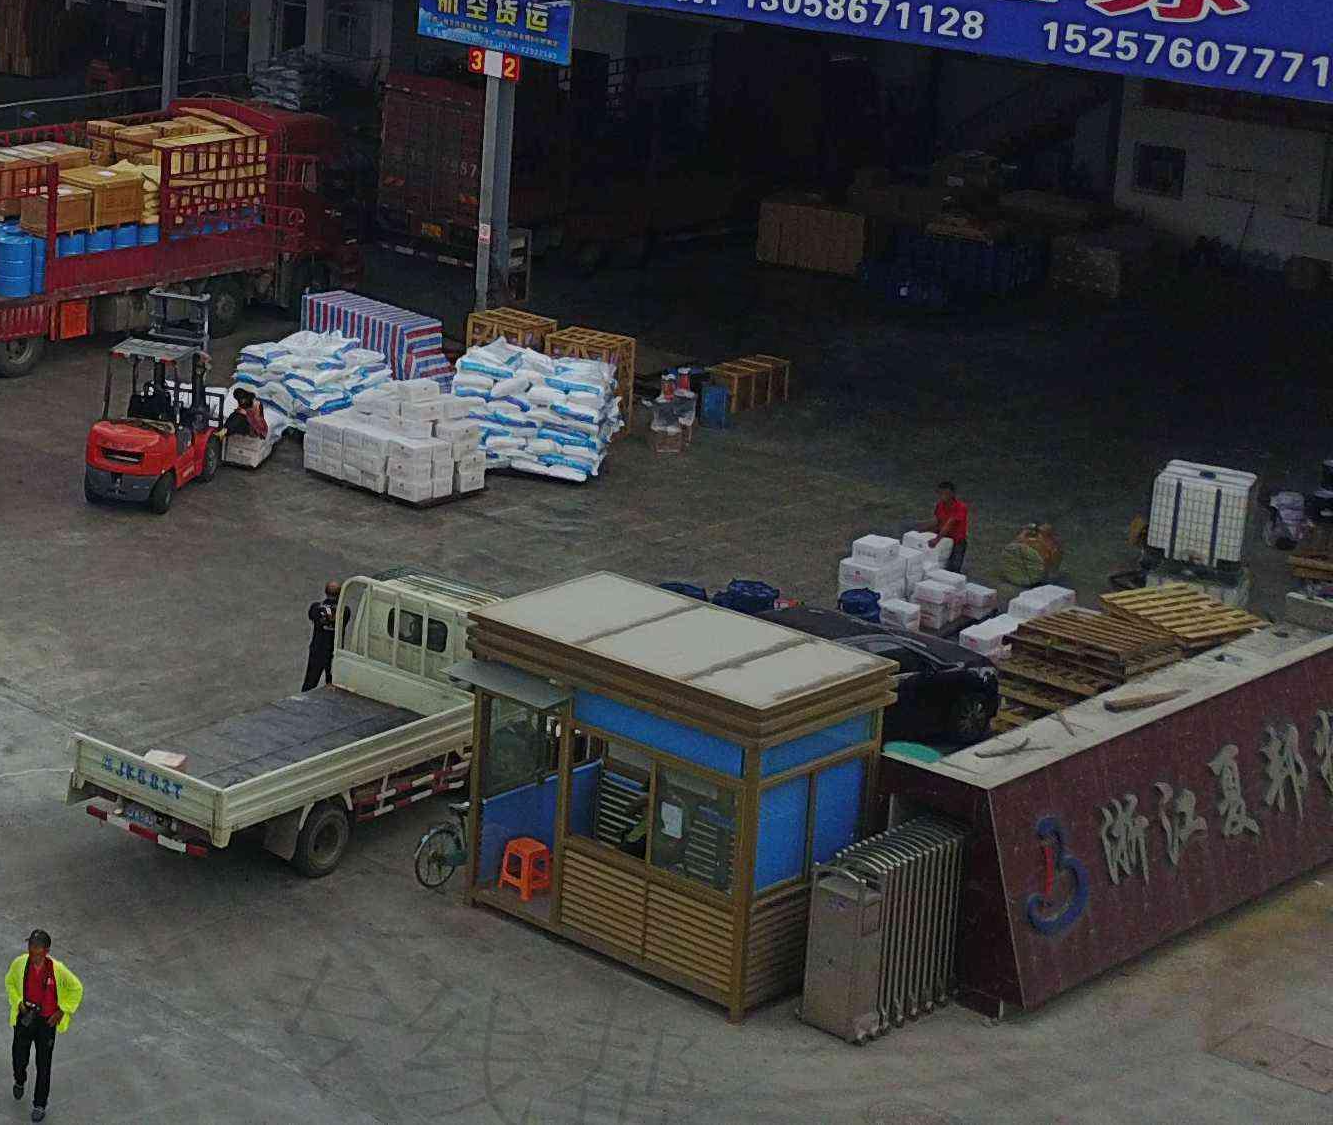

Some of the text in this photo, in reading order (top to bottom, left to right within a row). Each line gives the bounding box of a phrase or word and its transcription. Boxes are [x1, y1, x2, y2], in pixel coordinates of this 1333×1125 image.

[471, 50, 483, 71] 3
[1042, 21, 1330, 87] 15257607771
[504, 56, 516, 78] 2
